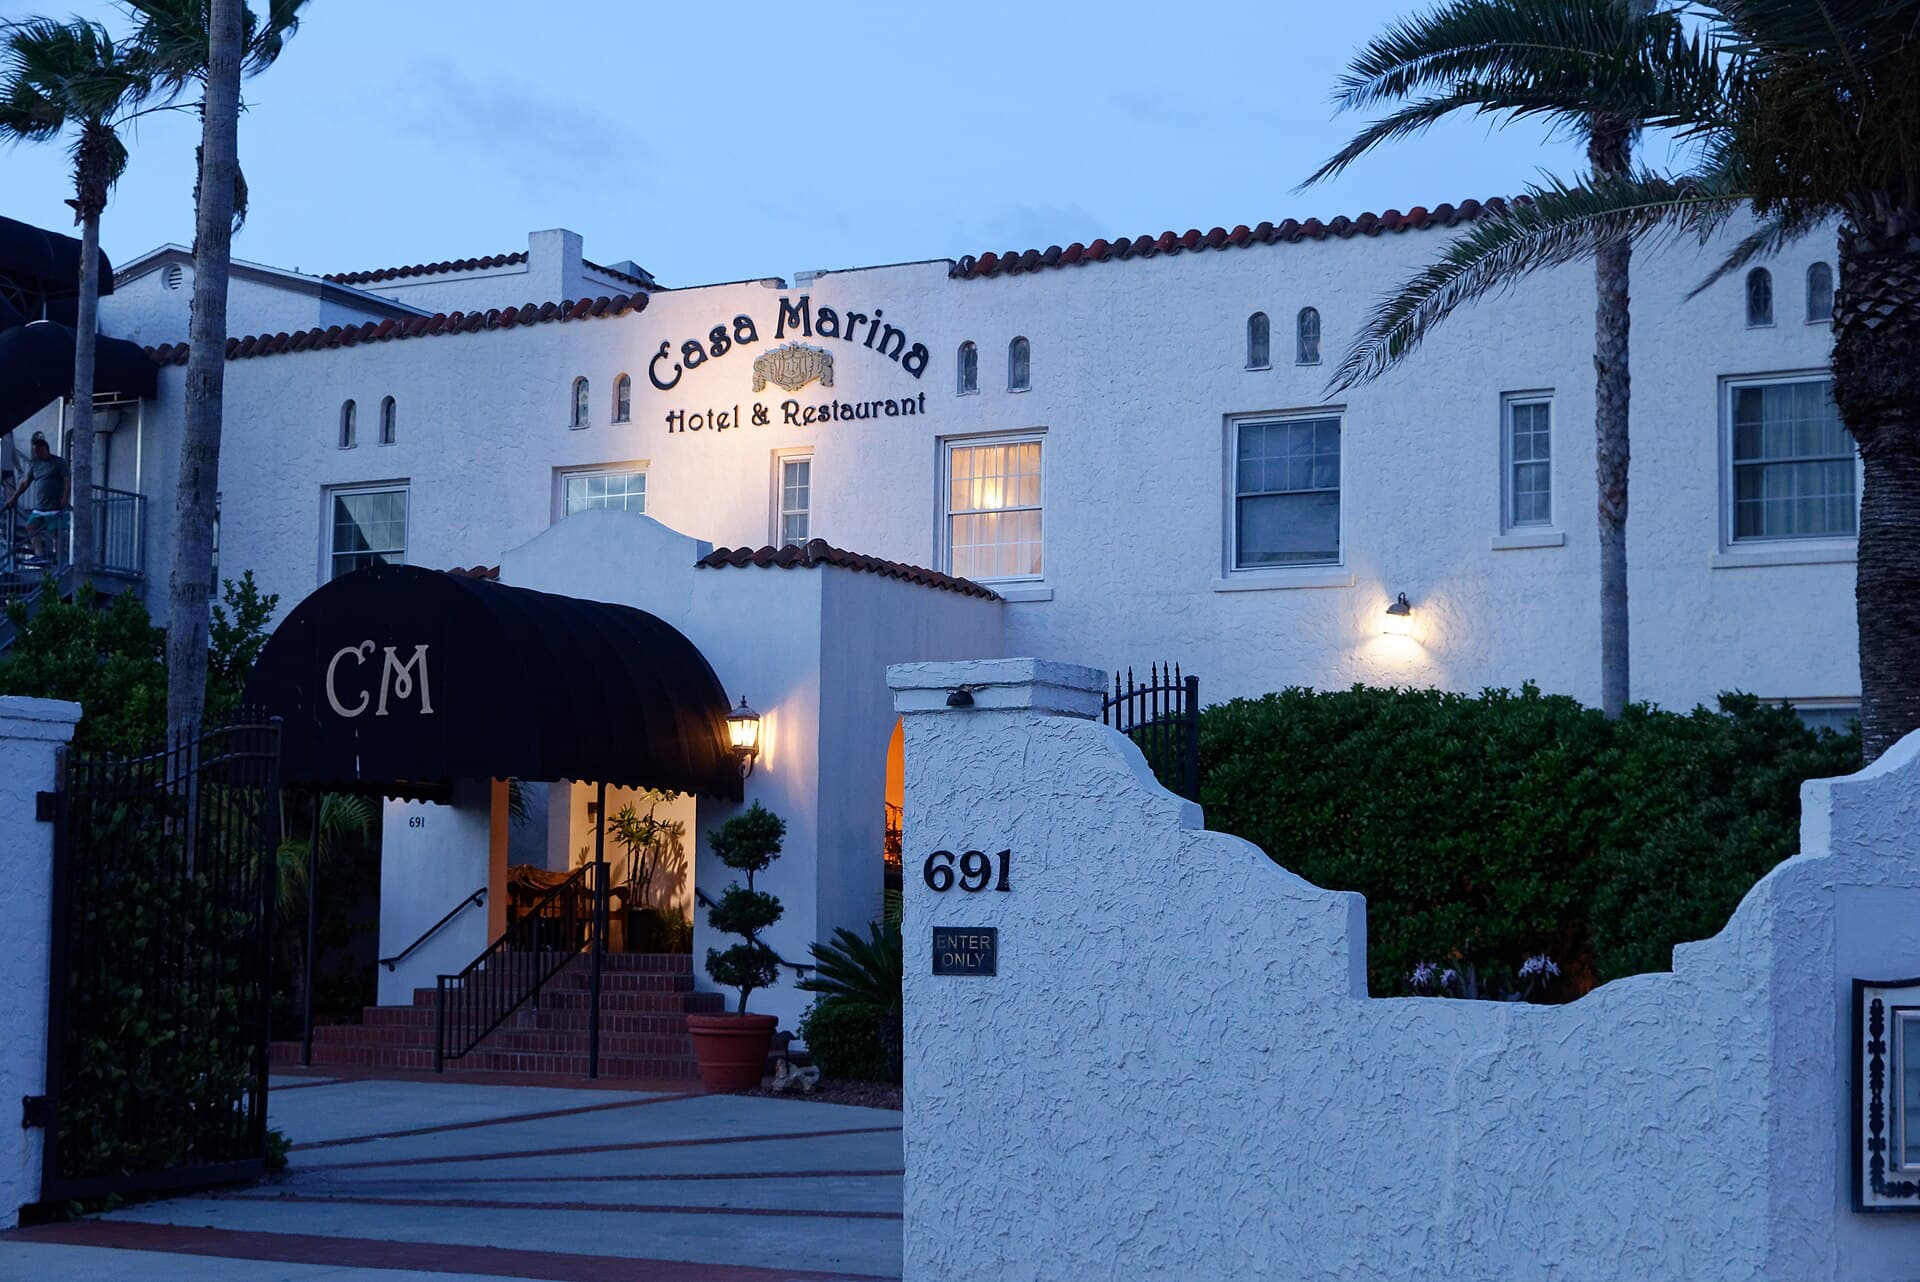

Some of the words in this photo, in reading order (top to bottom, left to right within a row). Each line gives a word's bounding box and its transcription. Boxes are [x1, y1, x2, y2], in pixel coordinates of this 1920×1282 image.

[649, 314, 760, 391] Casa
[774, 296, 930, 380] Marina
[665, 404, 740, 434] Hotel
[751, 402, 771, 426] &
[780, 391, 926, 427] Restaurant
[326, 639, 434, 718] CM
[408, 816, 425, 828] 691
[923, 849, 1012, 893] 691
[936, 935, 991, 950] ENTER
[942, 952, 985, 967] ONLY
